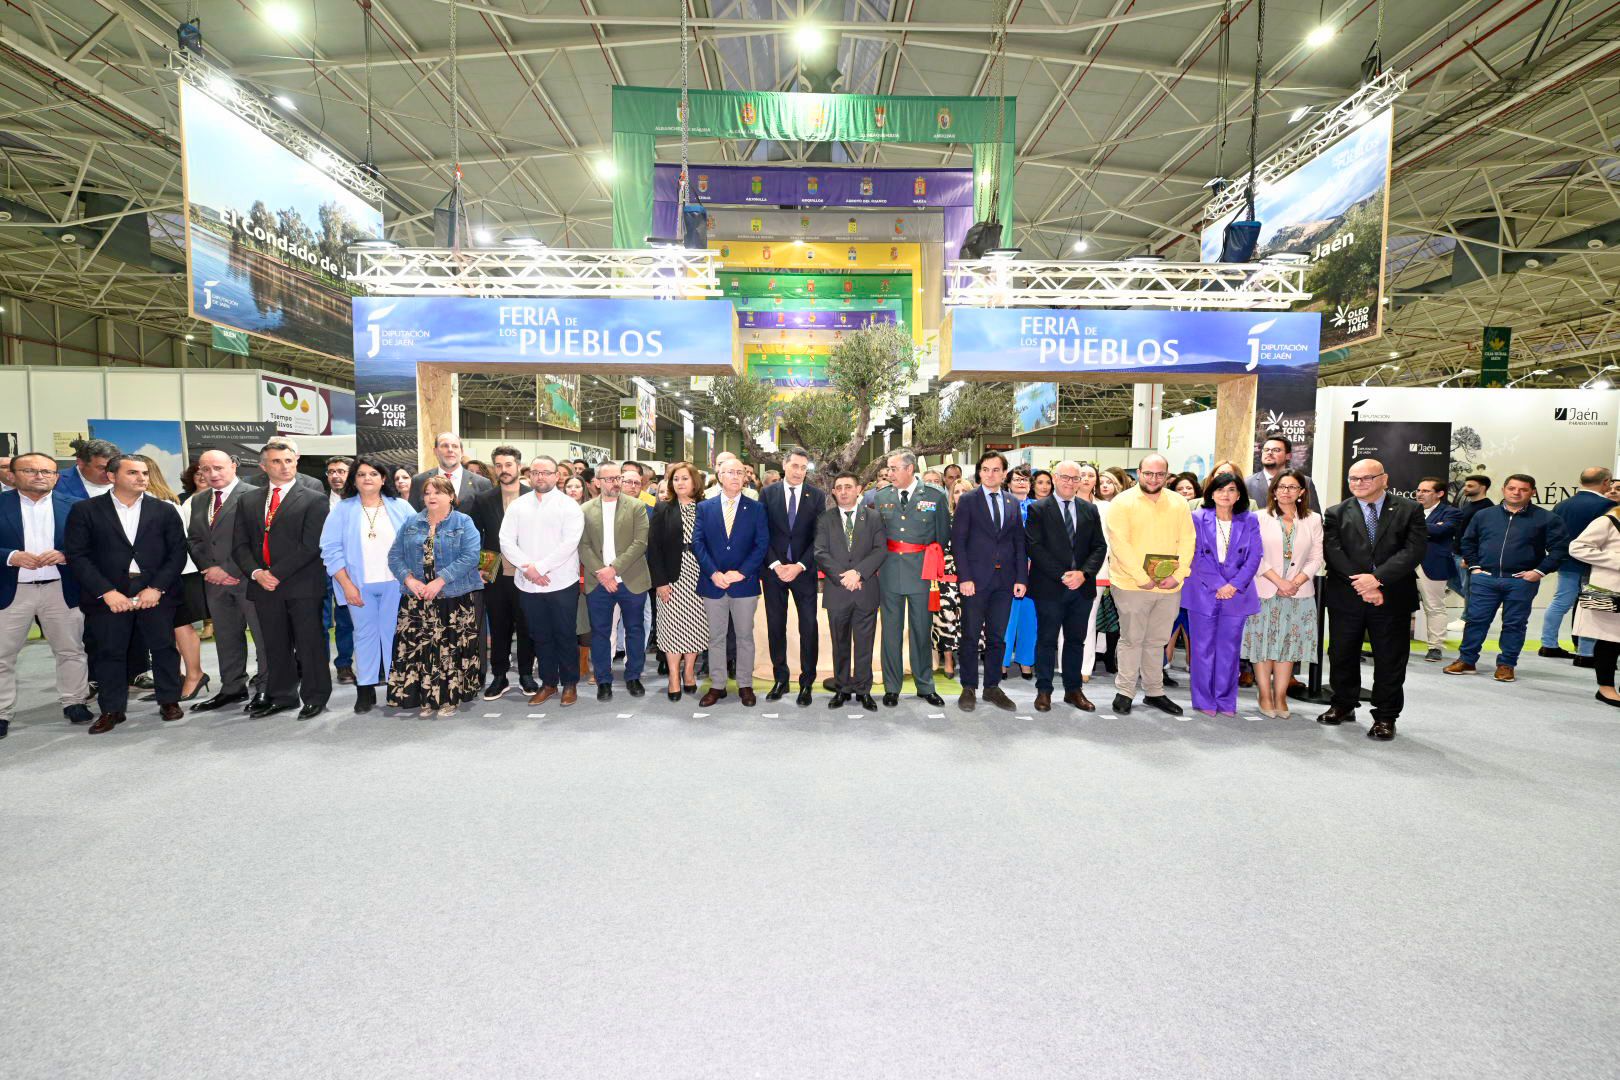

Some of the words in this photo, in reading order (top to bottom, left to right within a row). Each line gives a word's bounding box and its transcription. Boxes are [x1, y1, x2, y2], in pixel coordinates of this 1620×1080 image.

[220, 206, 237, 224] El
[242, 218, 317, 265] Condado
[320, 255, 338, 275] de
[1312, 232, 1355, 262] Jaén
[499, 306, 561, 326] FERIA
[565, 317, 578, 326] DE
[1348, 306, 1370, 319] OLEO
[1348, 314, 1369, 326] TOUR
[1020, 316, 1080, 336] FERIA
[1085, 326, 1098, 336] DE
[1347, 321, 1369, 335] JAÉN
[382, 328, 430, 337] DIPUTACIÓN
[382, 338, 393, 346] DE
[394, 337, 414, 346] JAÉN
[499, 328, 517, 337] LOS
[519, 328, 663, 357] PUEBLOS
[1020, 337, 1038, 346] LOS
[1039, 338, 1179, 365] PUEBLOS
[1261, 342, 1309, 352] DIPUTACIÓN
[1261, 352, 1272, 360] DE
[1272, 351, 1292, 360] JAÉN
[381, 403, 406, 412] OLEO
[270, 412, 293, 422] Tiempo
[381, 411, 406, 420] TOUR
[1569, 407, 1599, 421] Jaén
[275, 420, 293, 429] livos
[381, 418, 406, 427] JAÉN
[1282, 419, 1306, 428] OLEO
[195, 424, 220, 432] NAVAS
[231, 425, 246, 433] SAN
[246, 425, 265, 433] JUAN
[1282, 427, 1306, 435] TOUR
[1285, 433, 1306, 442] AÉN
[1417, 443, 1437, 452] Jaén
[1531, 481, 1579, 505] AÉN
